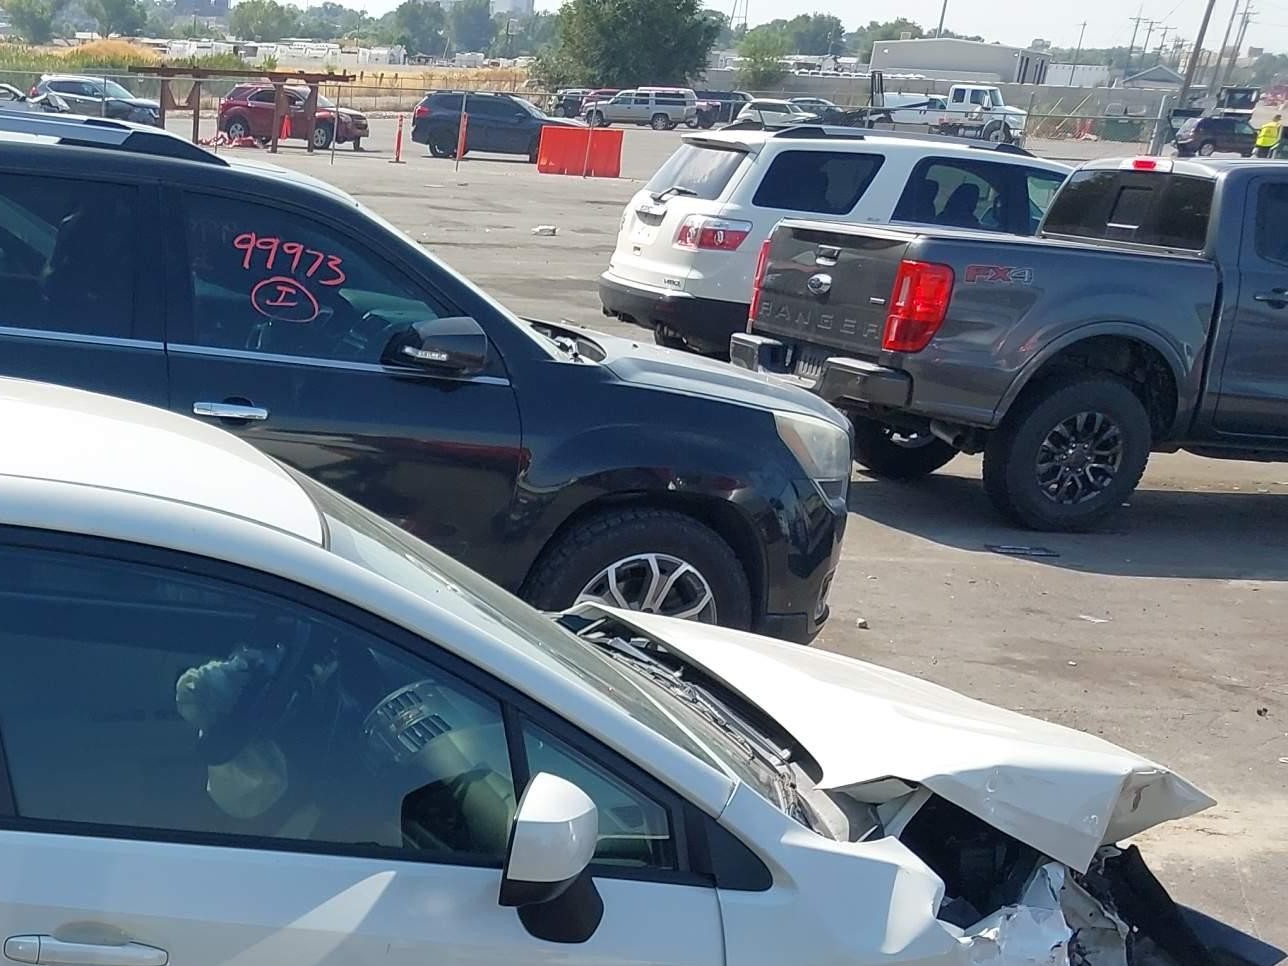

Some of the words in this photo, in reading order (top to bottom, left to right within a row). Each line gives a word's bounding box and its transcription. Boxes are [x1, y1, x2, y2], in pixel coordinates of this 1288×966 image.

[233, 232, 347, 286] 99973
[964, 264, 1033, 285] FX4
[758, 302, 882, 340] RANGER
